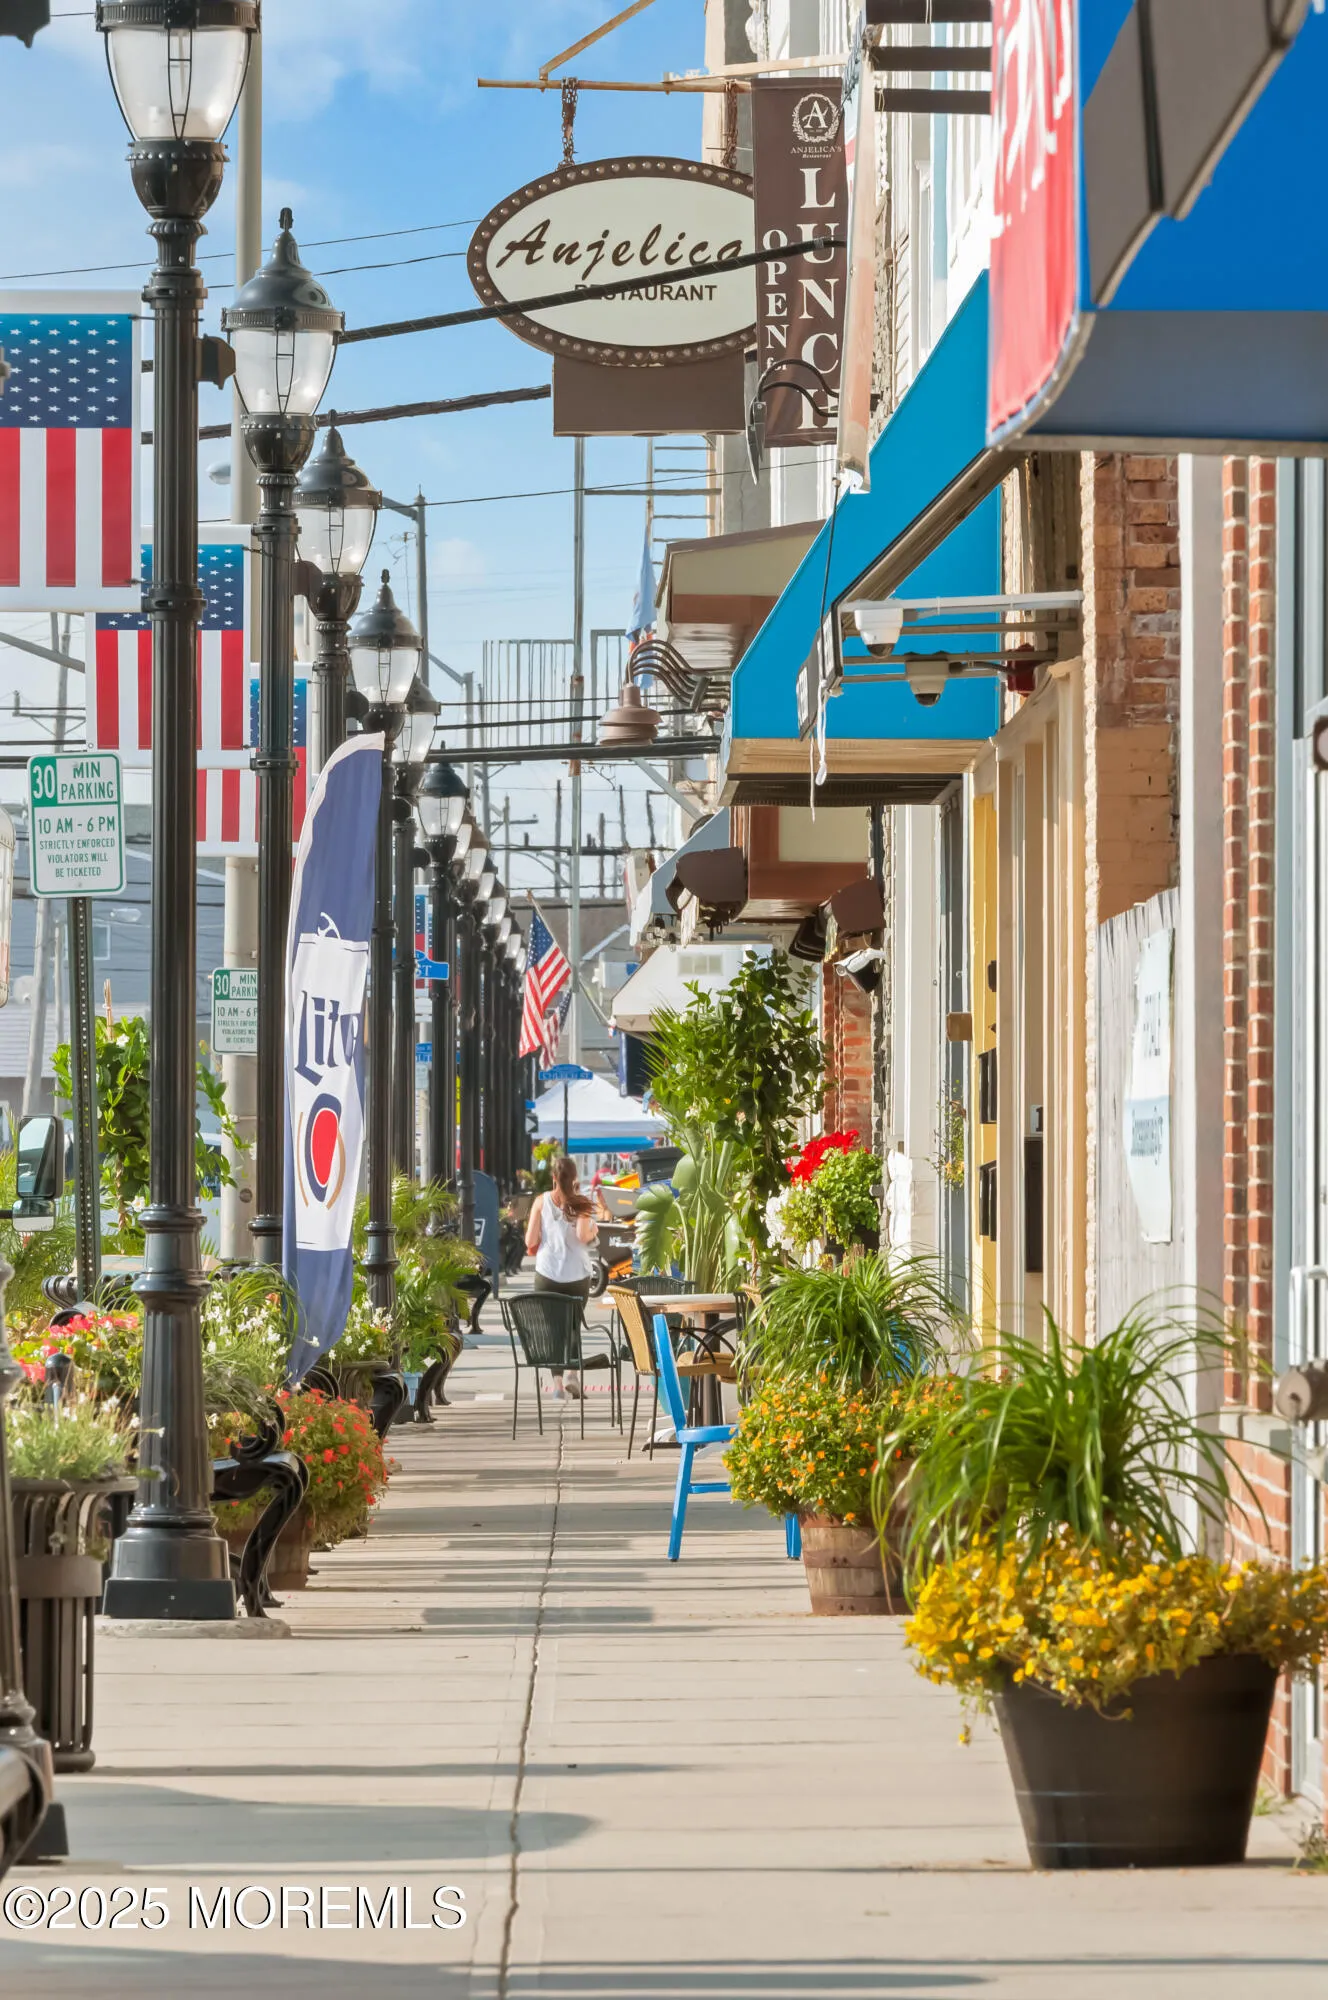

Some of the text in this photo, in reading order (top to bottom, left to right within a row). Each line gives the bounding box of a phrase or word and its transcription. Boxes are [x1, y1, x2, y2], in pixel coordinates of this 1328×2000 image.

[790, 146, 842, 154] ANJELICA'S
[496, 218, 743, 281] Anjelica
[574, 284, 718, 301] TAURANT
[762, 229, 789, 349] OPEN
[797, 167, 841, 429] LUNCH
[73, 761, 101, 779] MIN
[32, 764, 56, 799] 30
[61, 781, 114, 801] PARKING
[38, 818, 51, 834] 10
[56, 817, 73, 833] AM
[87, 817, 94, 833] 6
[98, 816, 115, 832] PM
[39, 837, 116, 850] STRICTLY ENFORCED
[47, 852, 108, 864] VIOLATORS WILL
[55, 866, 101, 878] BE TICKETED
[215, 974, 229, 996] 30
[239, 973, 257, 985] MIN
[231, 986, 258, 998] PARKIN
[217, 1006, 225, 1017] 10
[227, 1007, 239, 1017] AM
[246, 1007, 251, 1017] 6
